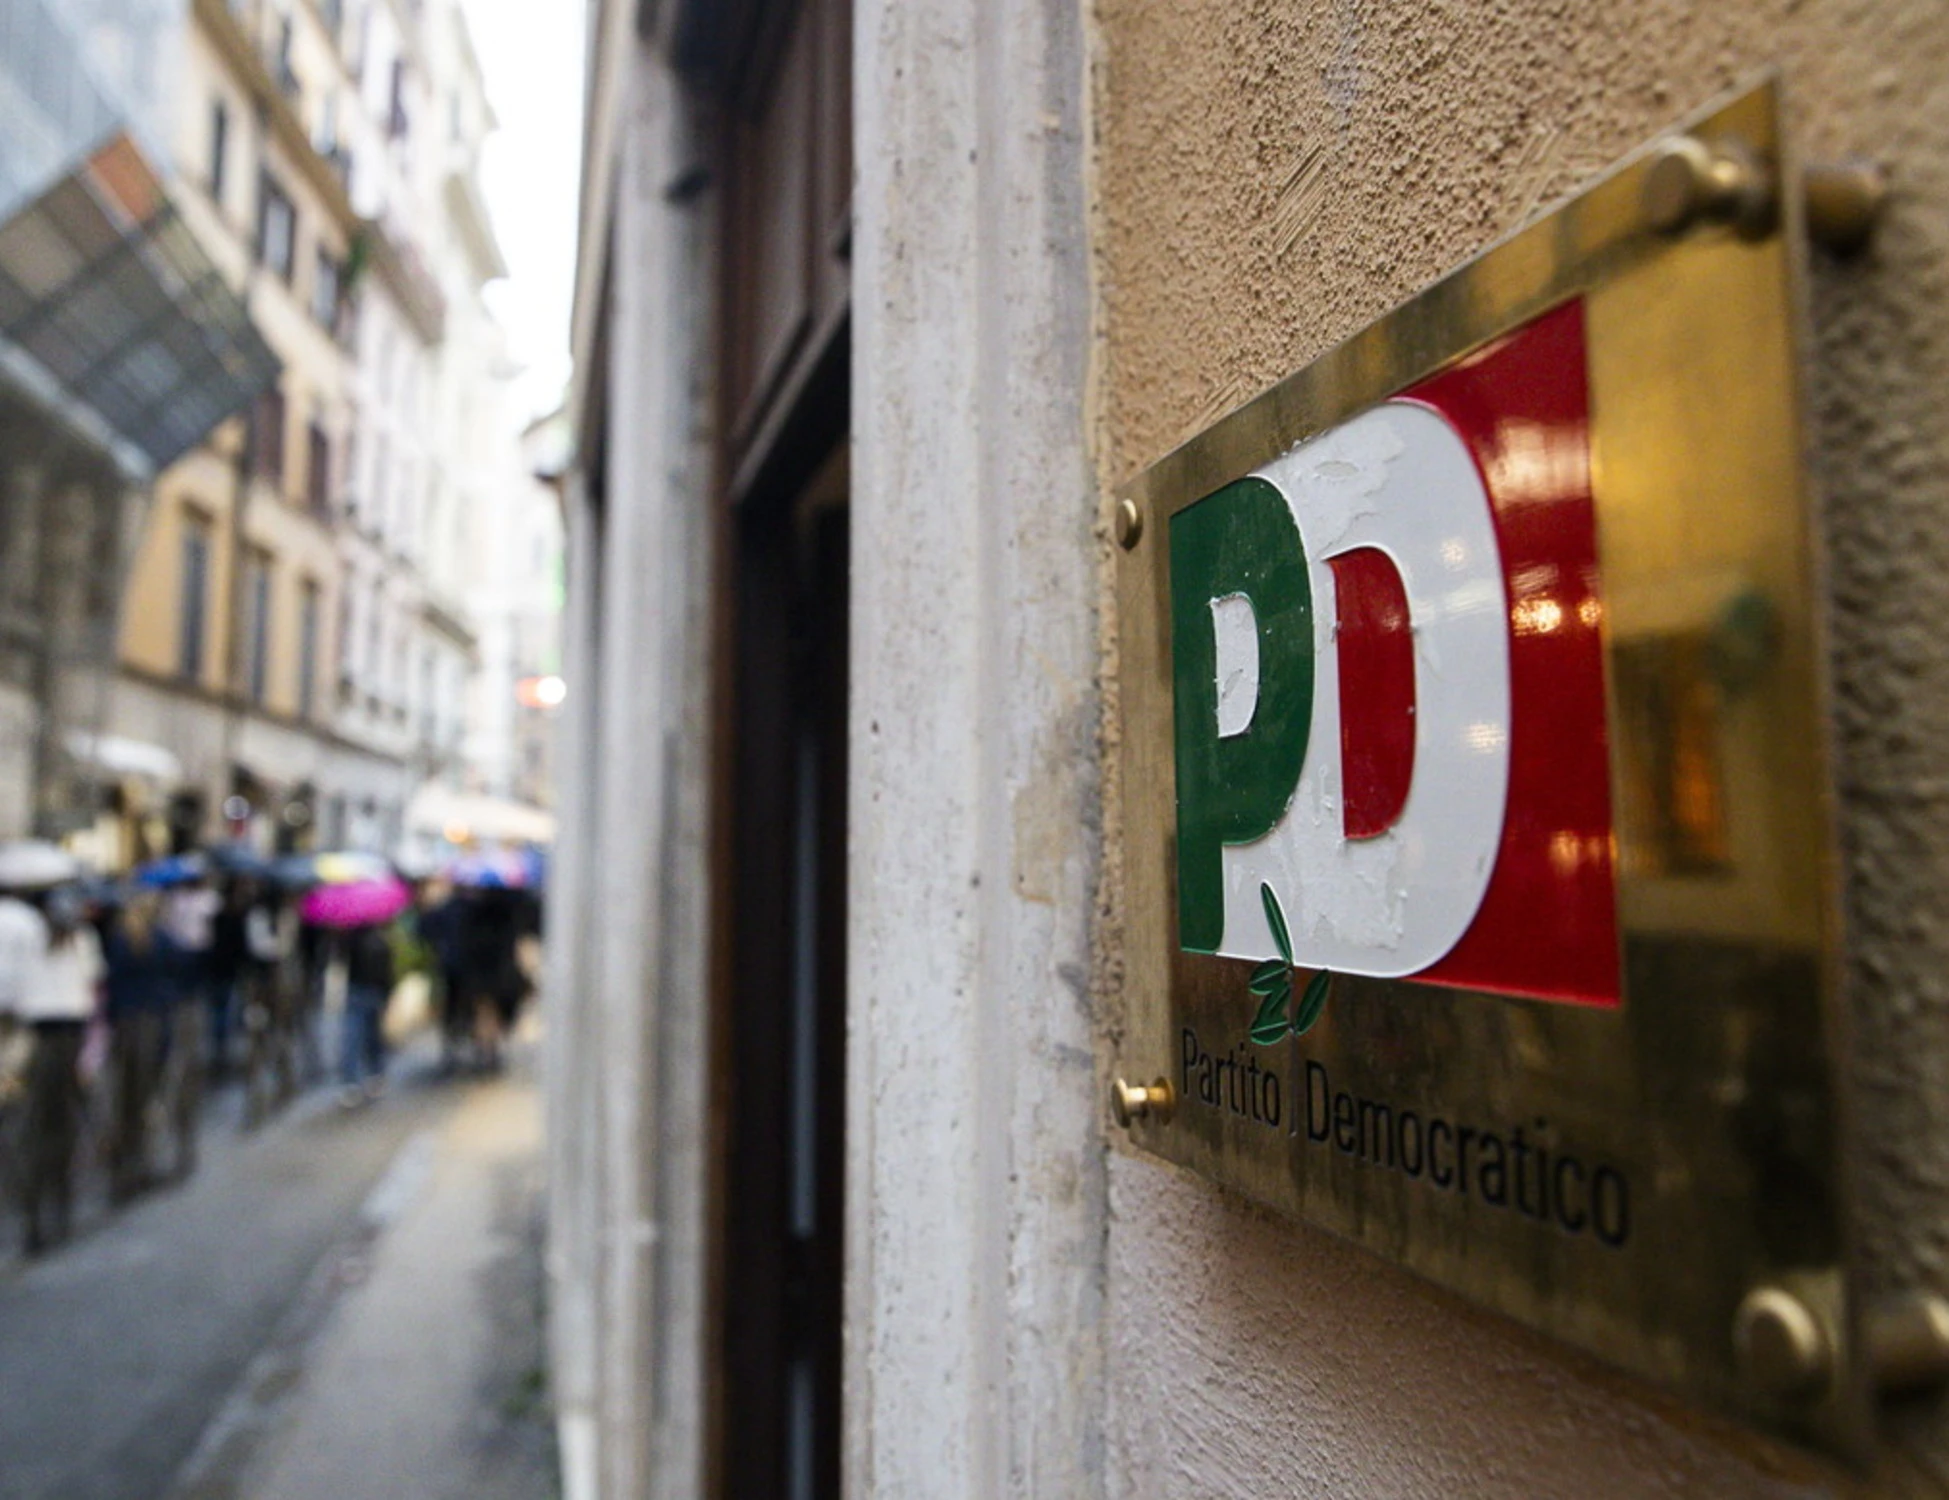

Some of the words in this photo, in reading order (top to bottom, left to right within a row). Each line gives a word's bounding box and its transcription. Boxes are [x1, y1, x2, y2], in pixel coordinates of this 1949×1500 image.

[1170, 399, 1512, 977] PD
[1182, 1028, 1281, 1128] Partito
[1306, 1060, 1630, 1248] Democratico
